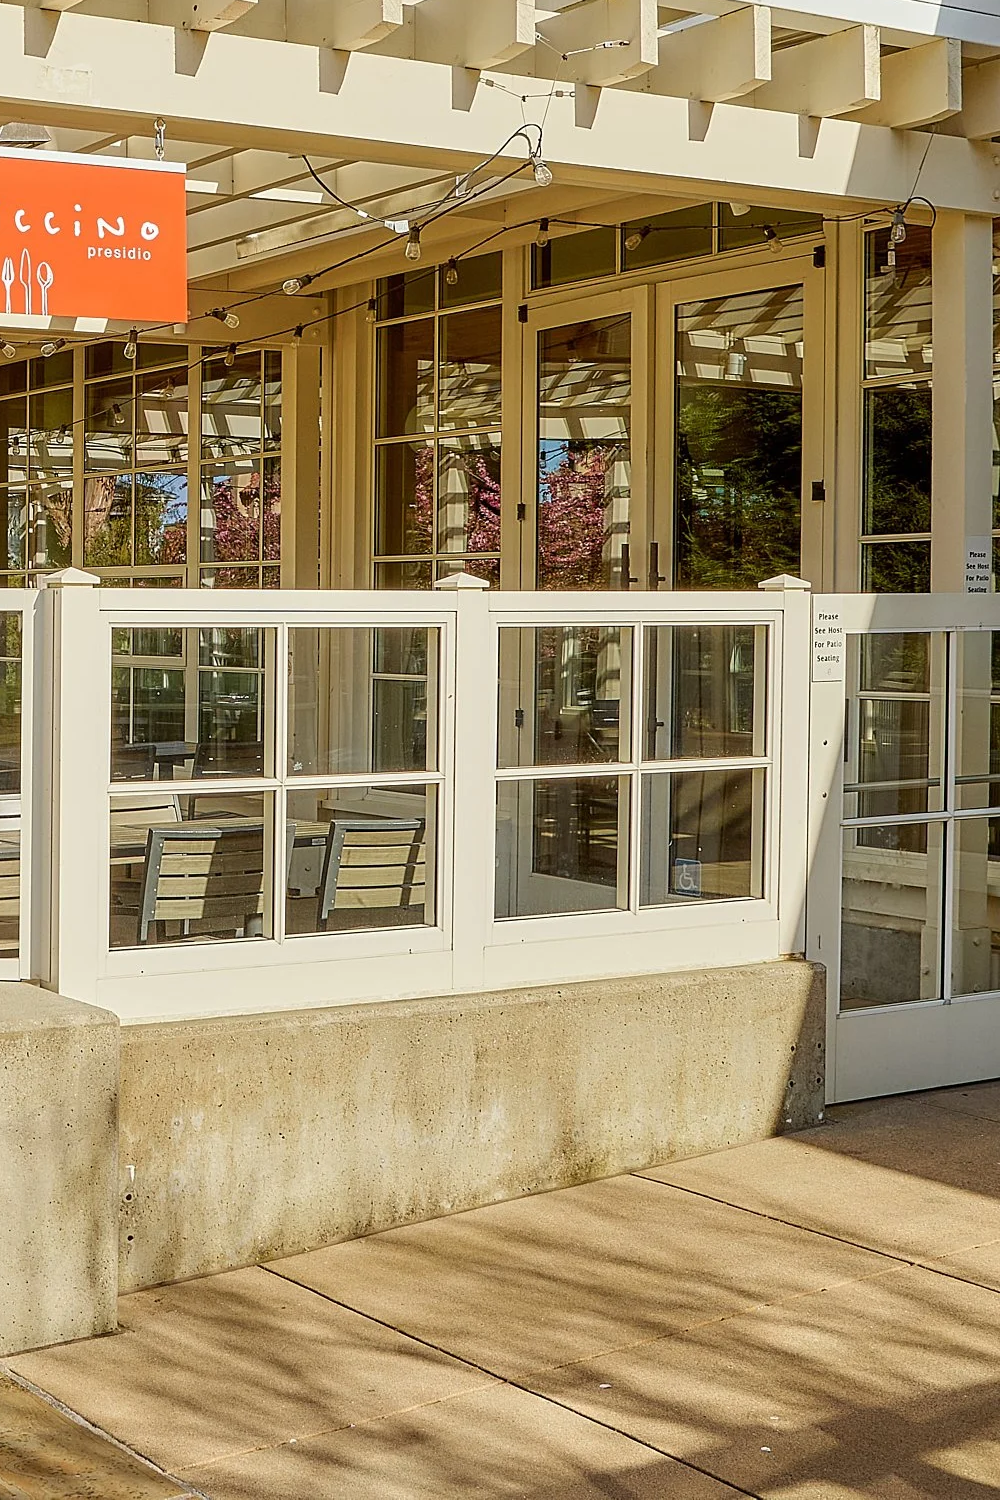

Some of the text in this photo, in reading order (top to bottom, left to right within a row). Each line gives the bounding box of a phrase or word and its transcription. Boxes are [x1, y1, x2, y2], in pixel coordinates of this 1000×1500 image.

[87, 246, 151, 260] presidio
[826, 640, 842, 648] Patio
[817, 655, 840, 663] Seating
